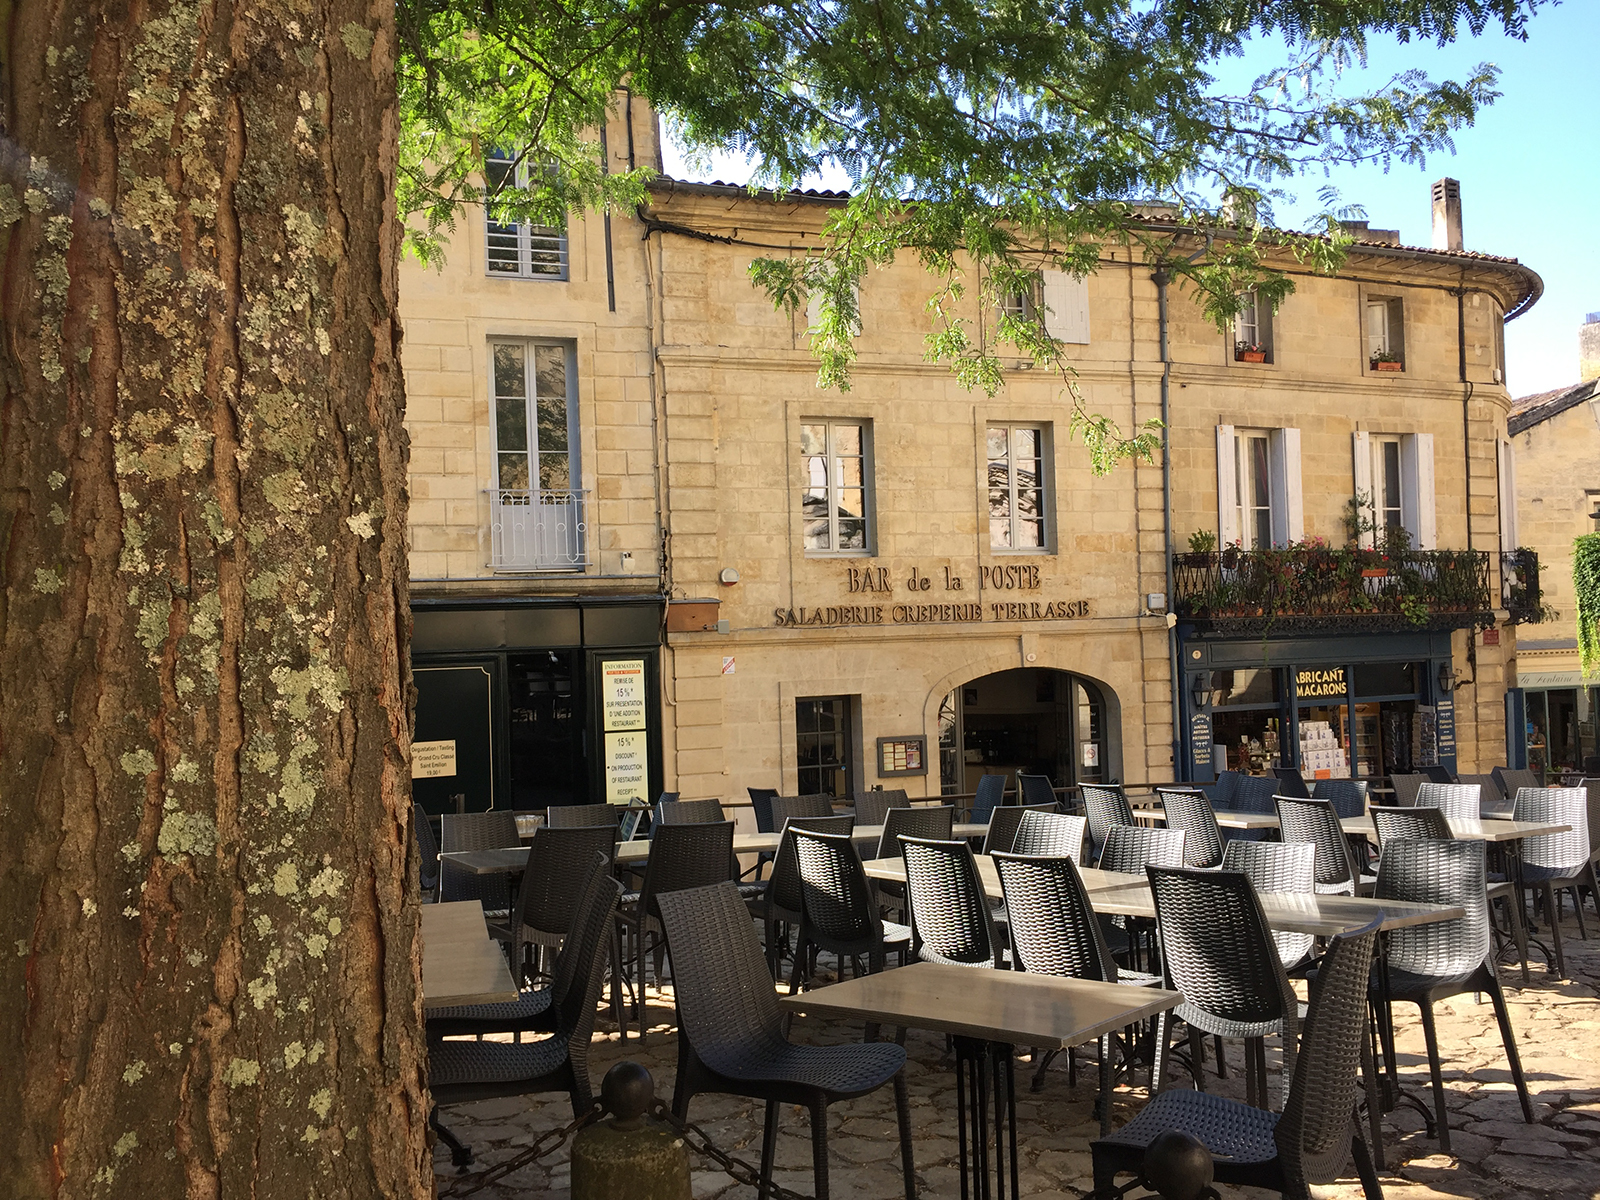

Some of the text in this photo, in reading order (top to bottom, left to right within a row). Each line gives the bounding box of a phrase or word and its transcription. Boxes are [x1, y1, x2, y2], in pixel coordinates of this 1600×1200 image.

[848, 565, 1040, 592] BAR de la POSTE
[775, 600, 1089, 626] SALADERIE CREPERIE TERRASSE
[1296, 682, 1347, 697] MACARONS
